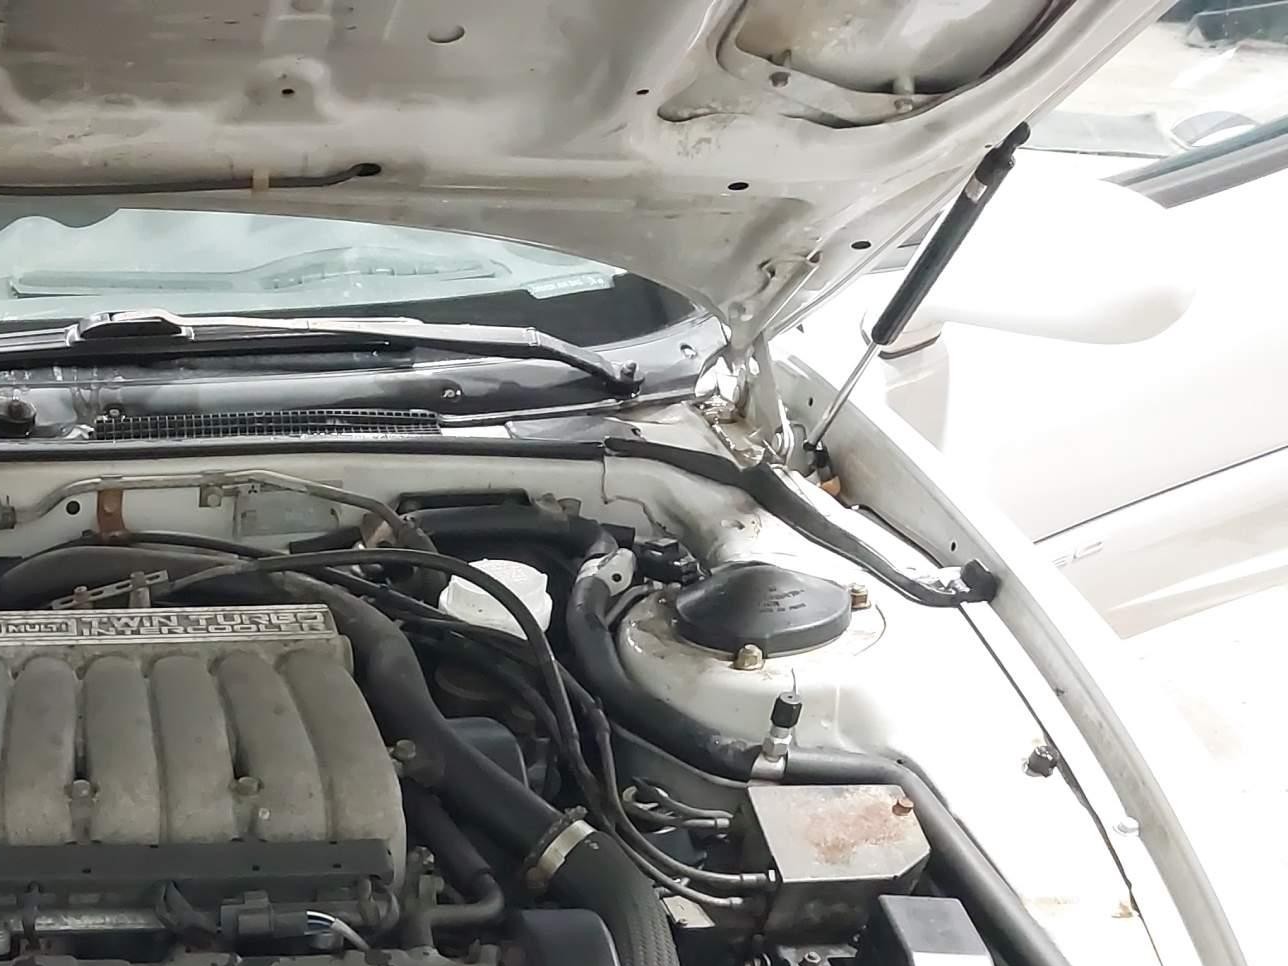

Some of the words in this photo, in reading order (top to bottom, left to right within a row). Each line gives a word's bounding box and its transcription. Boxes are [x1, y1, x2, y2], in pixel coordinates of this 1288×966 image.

[81, 614, 178, 629] TWIN
[188, 611, 325, 626] TURBO
[82, 622, 326, 636] INTERCOOLER
